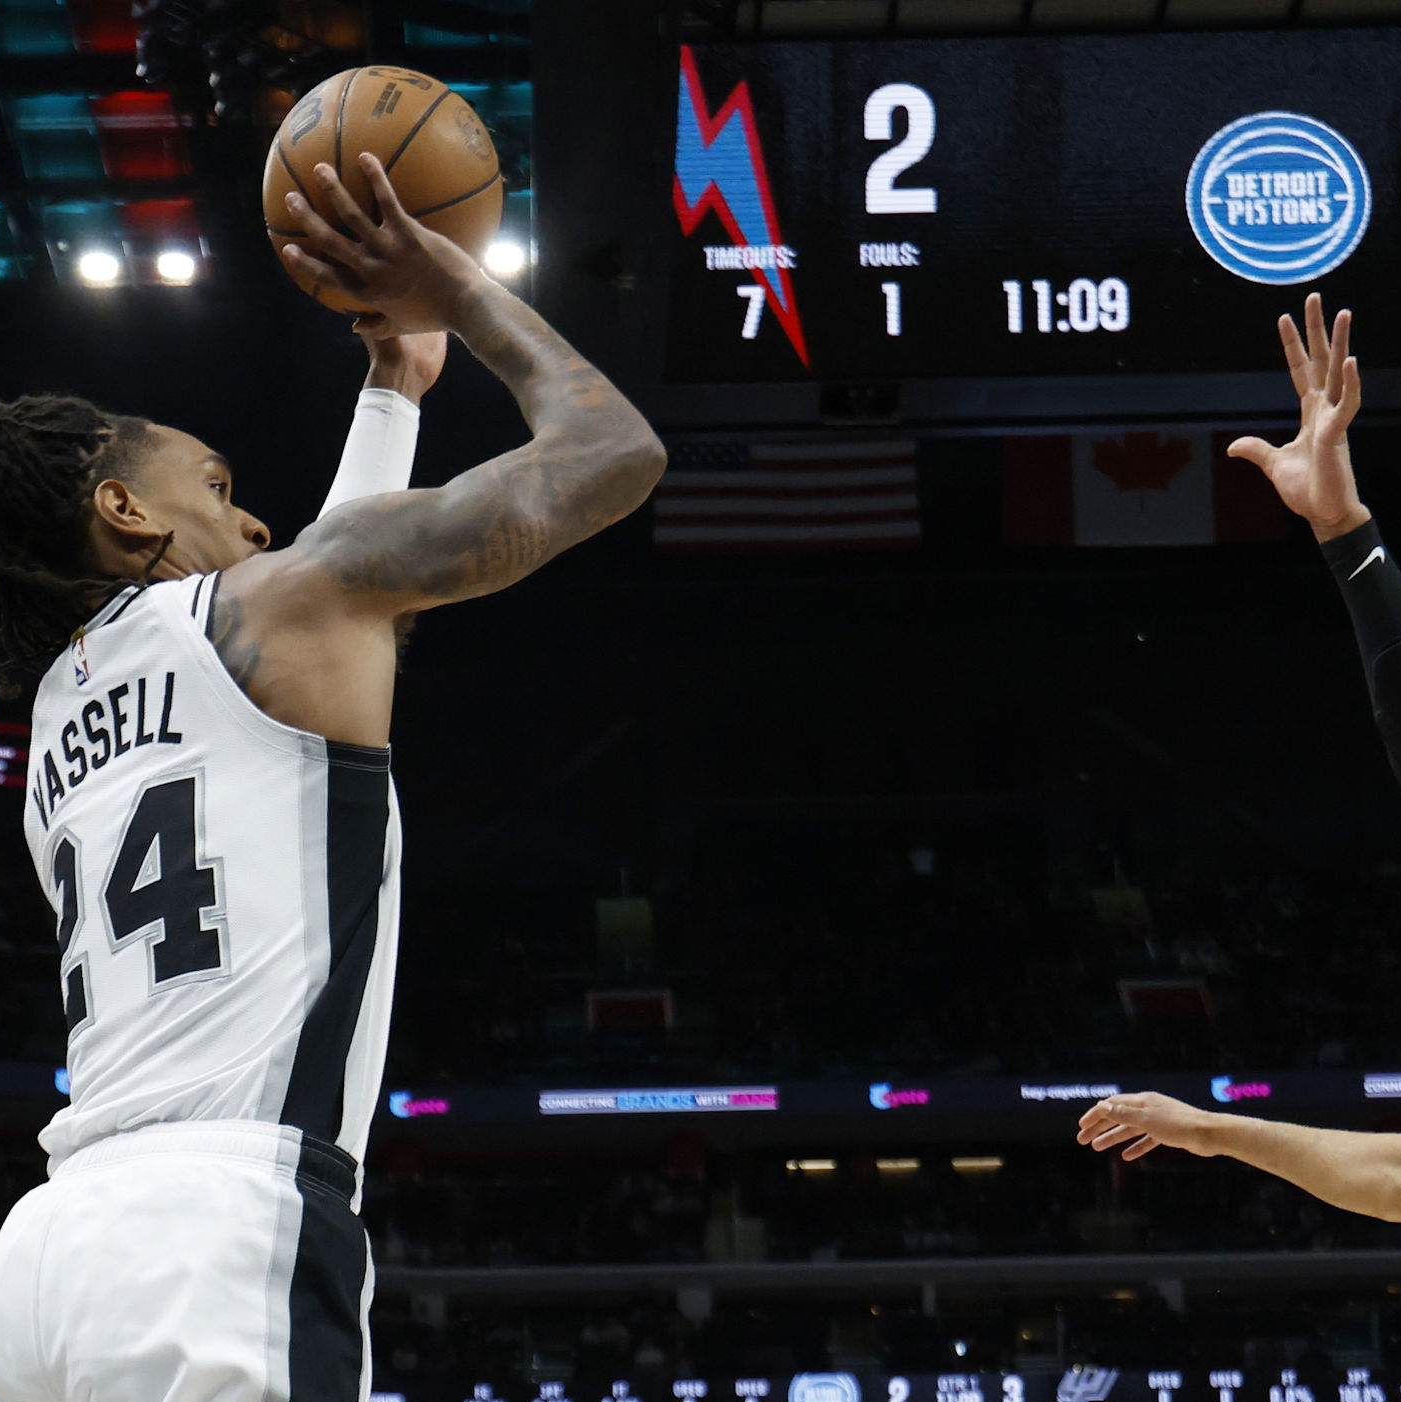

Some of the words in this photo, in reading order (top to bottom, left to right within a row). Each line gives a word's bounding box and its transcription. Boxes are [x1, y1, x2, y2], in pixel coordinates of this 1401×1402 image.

[863, 83, 938, 215] 2
[1226, 171, 1329, 199] DETROIT
[1227, 197, 1332, 225] PISTONS
[703, 243, 798, 270] TIMEOUTS:
[859, 242, 921, 267] FOULS:
[736, 284, 766, 339] 7
[880, 281, 903, 337] 1
[1002, 276, 1131, 334] 11:09
[32, 672, 183, 831] VASSELL
[52, 768, 231, 1045] 24
